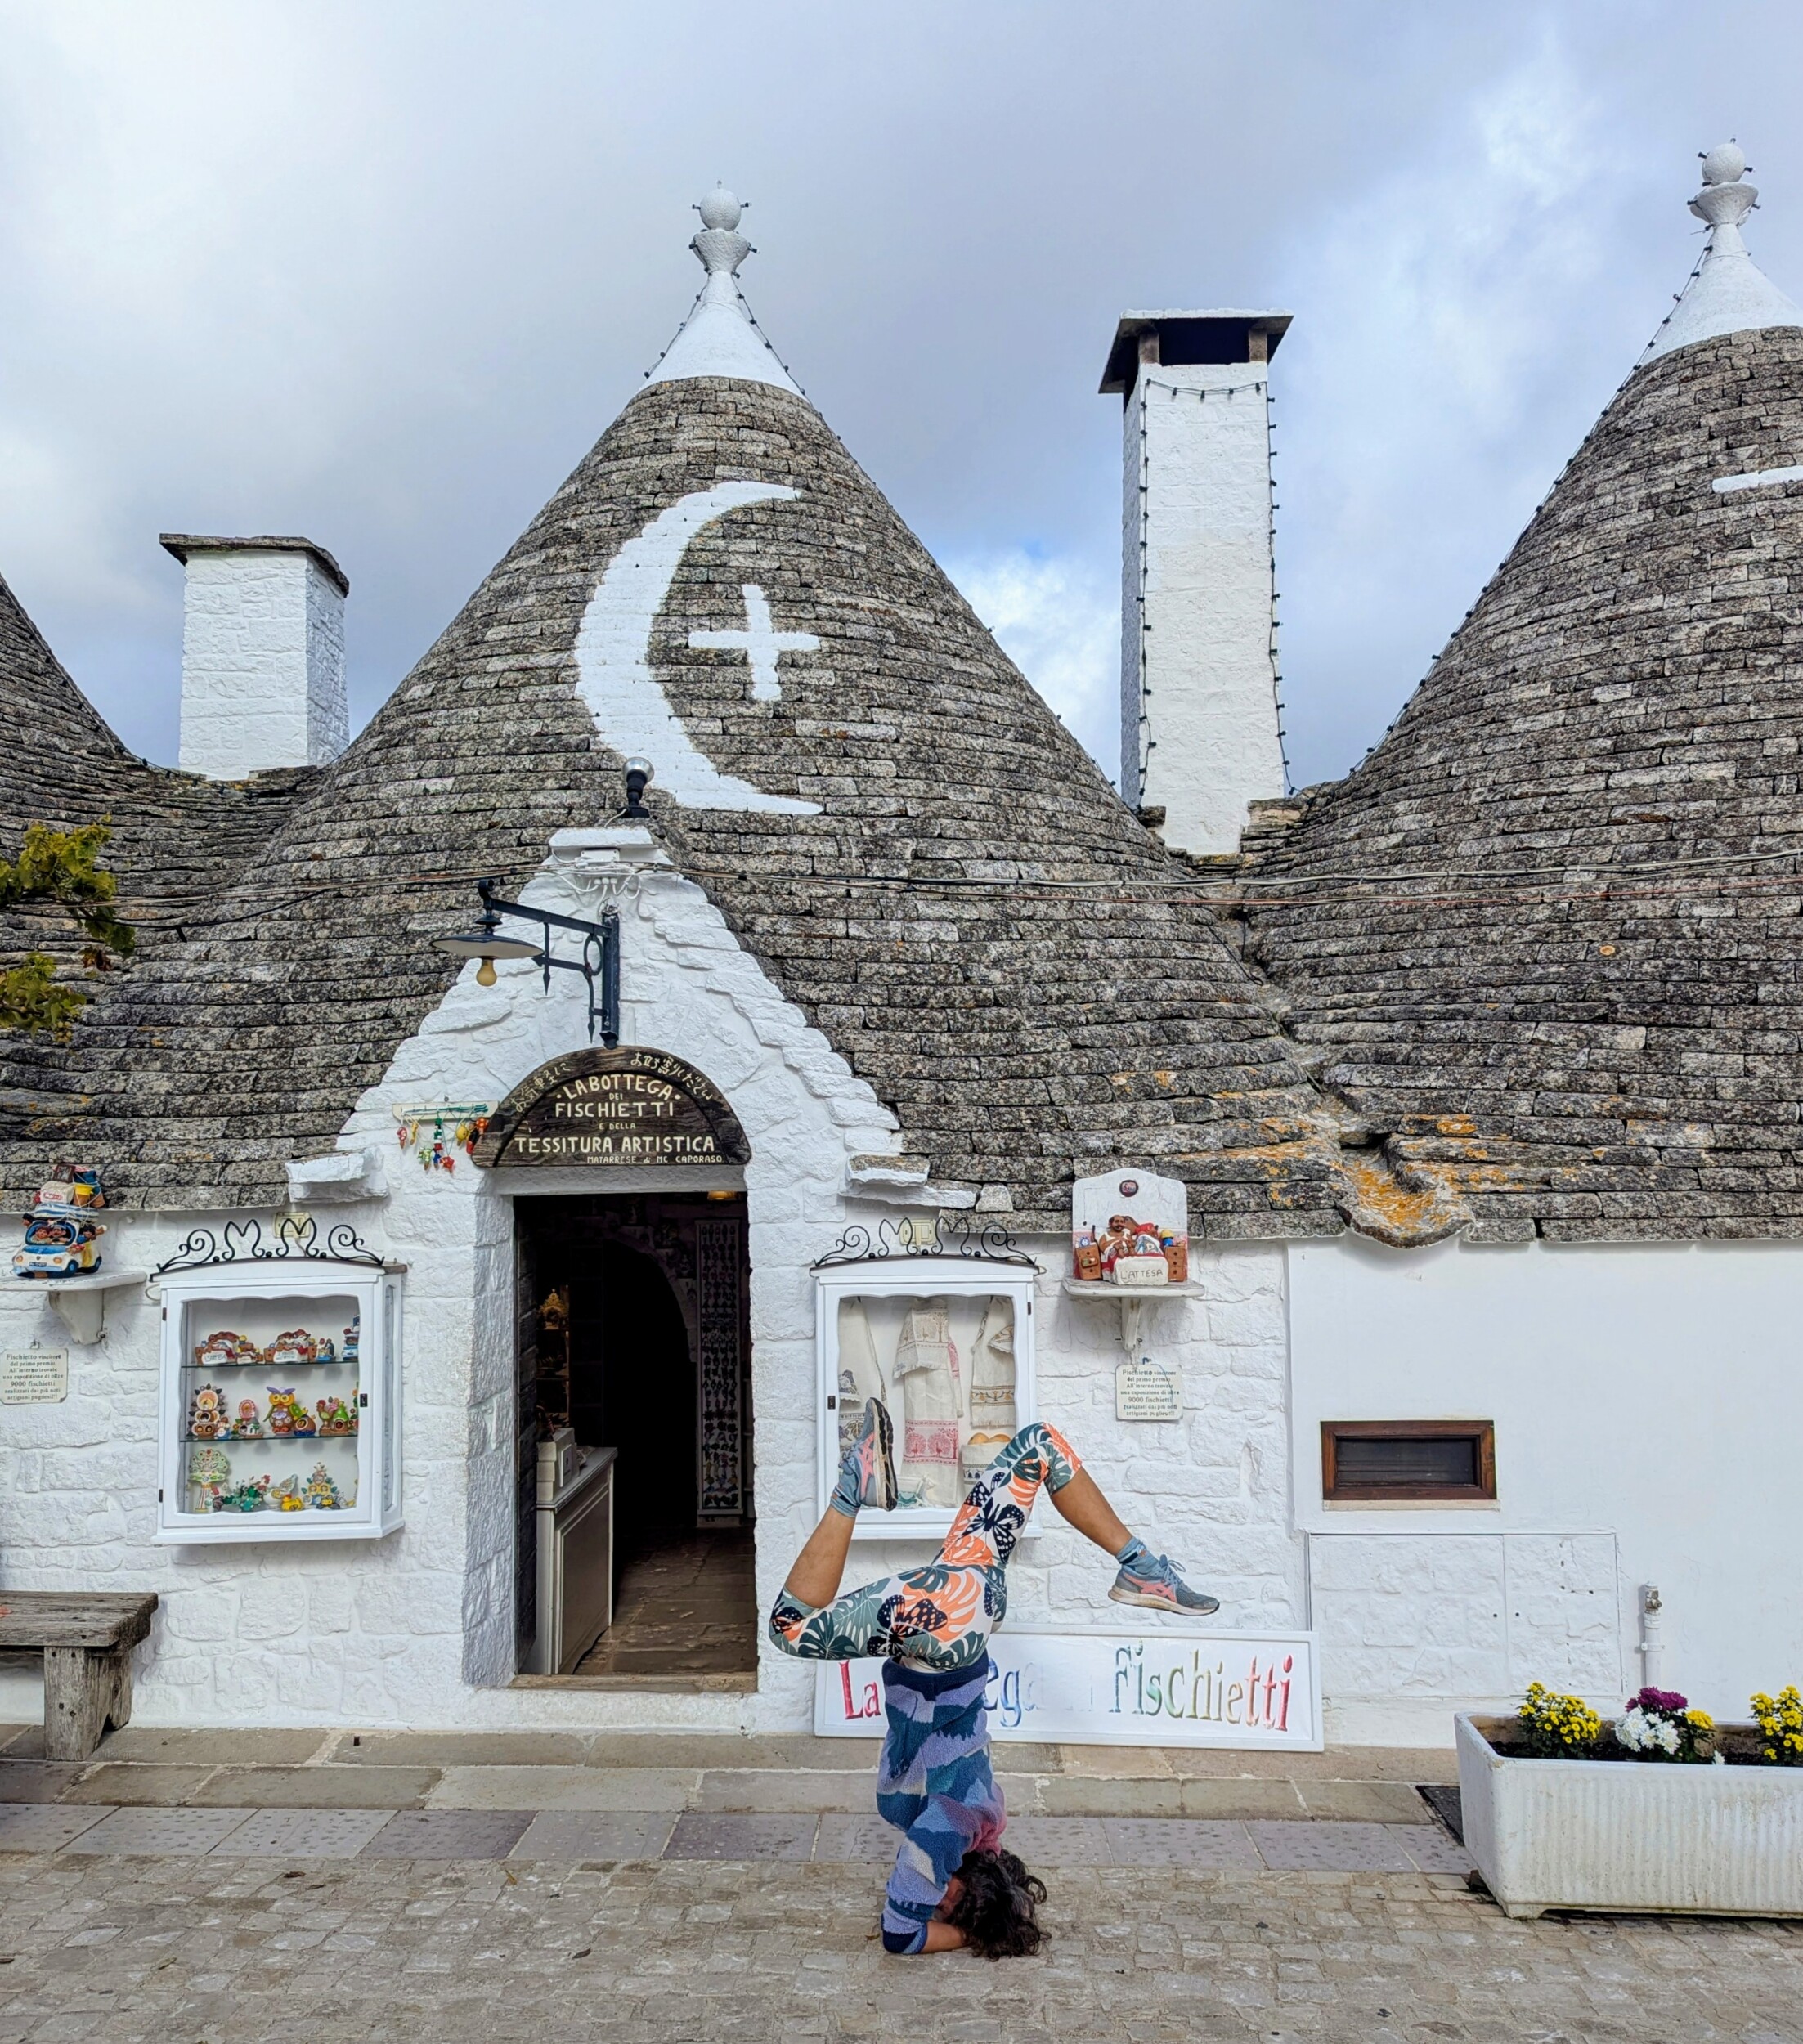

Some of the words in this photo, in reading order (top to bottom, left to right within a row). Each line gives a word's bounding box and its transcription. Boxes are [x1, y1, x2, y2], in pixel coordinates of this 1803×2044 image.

[555, 1102, 674, 1118] FISCHIETTI
[514, 1137, 612, 1153] TESSITURA
[621, 1136, 715, 1153] ARTISTICA
[587, 1155, 637, 1163] MATARRESE
[657, 1155, 668, 1163] MC
[1120, 1270, 1163, 1280] L'ATTESA
[838, 1659, 881, 1720] La
[1108, 1639, 1291, 1732] Fischietti
